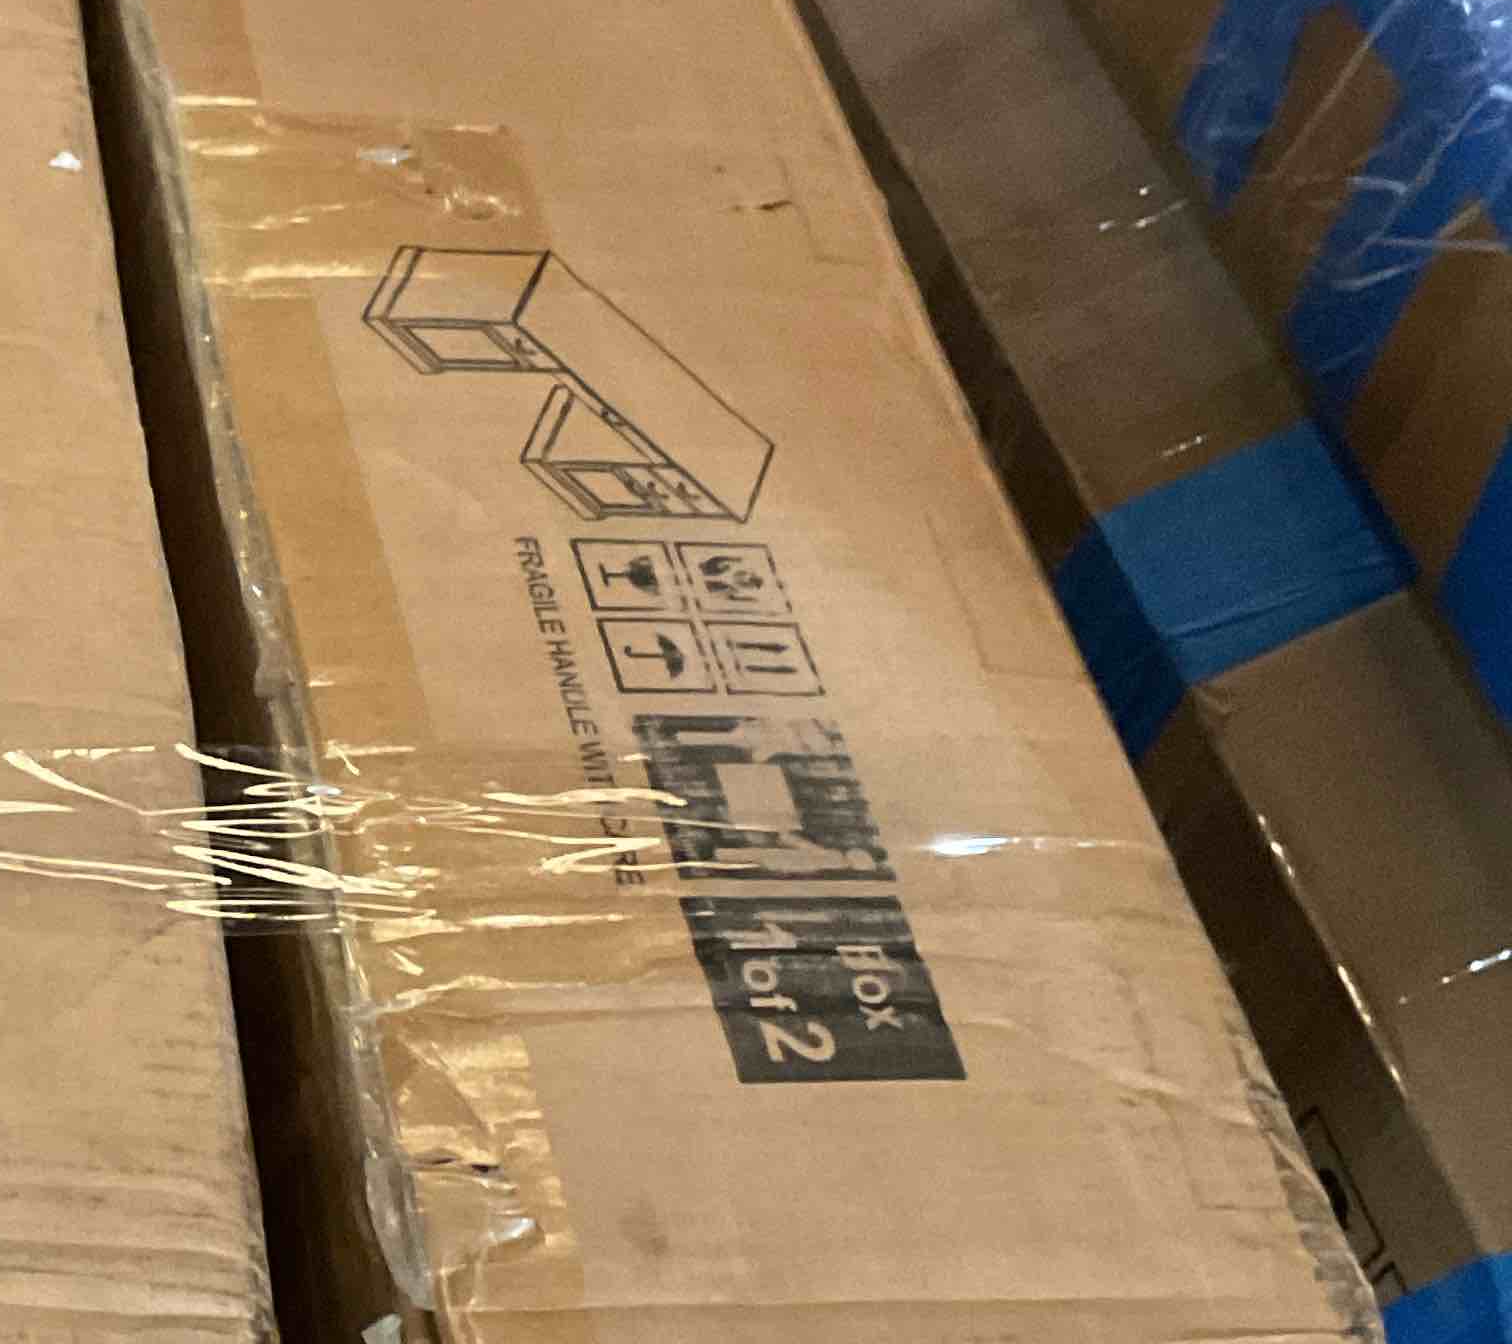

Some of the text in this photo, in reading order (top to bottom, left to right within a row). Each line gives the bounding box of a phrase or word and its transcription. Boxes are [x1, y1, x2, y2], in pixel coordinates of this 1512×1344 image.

[514, 535, 565, 634] FRAGILE
[549, 637, 599, 739] HANDLE
[742, 958, 801, 1014] of
[758, 1019, 837, 1064] 2
